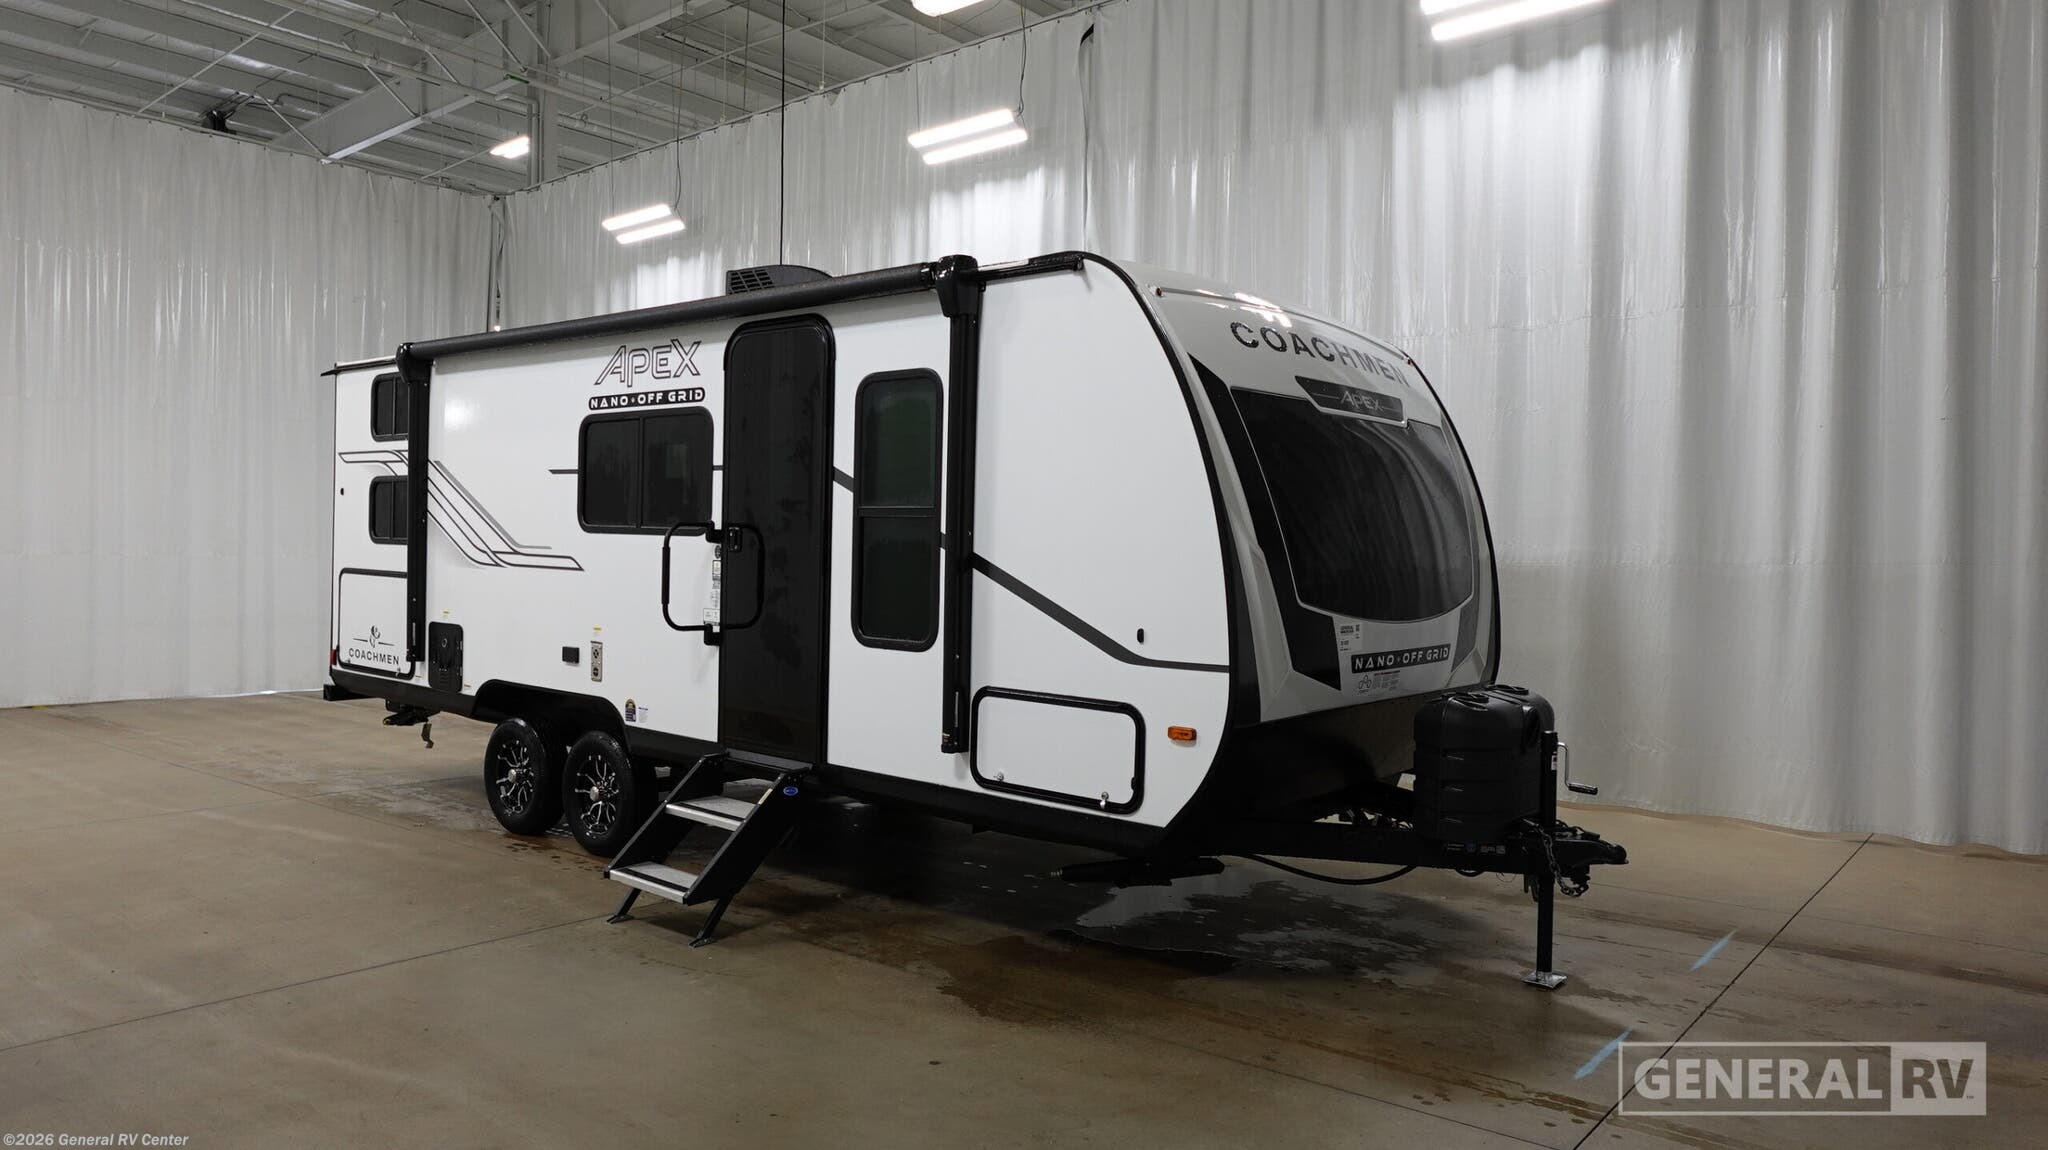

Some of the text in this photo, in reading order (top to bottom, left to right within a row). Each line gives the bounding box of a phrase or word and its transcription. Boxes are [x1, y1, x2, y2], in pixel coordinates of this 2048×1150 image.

[1230, 321, 1410, 388] COACHMEN
[590, 389, 703, 409] NANO OFF GRID
[348, 647, 400, 666] COACHMEN
[1354, 647, 1449, 671] NANO OFF GRID
